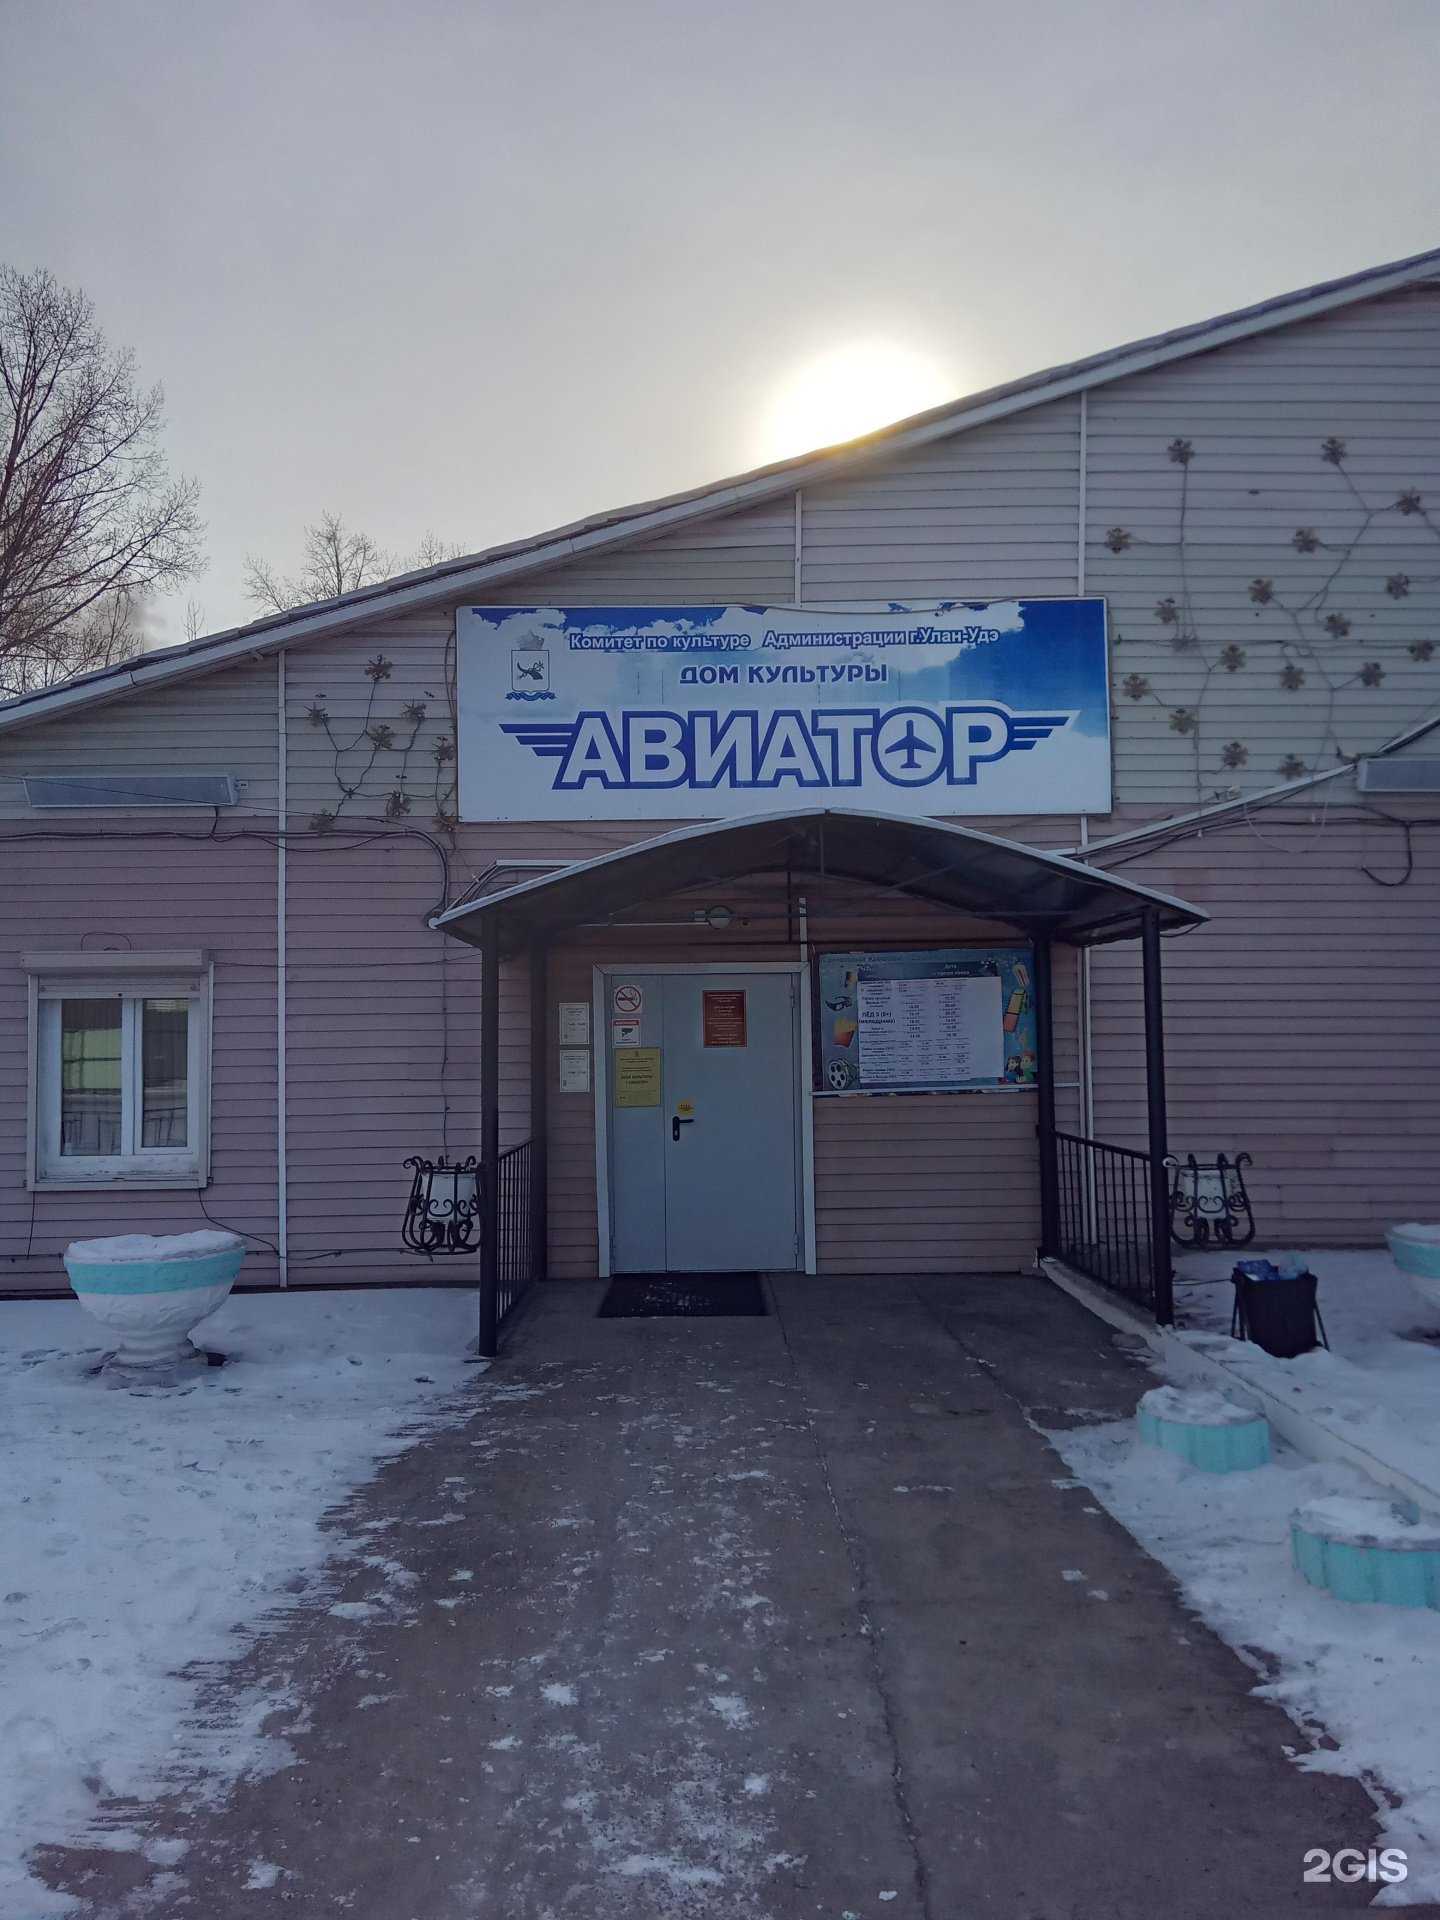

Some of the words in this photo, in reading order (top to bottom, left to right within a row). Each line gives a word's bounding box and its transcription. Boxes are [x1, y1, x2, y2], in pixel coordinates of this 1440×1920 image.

[571, 634, 642, 649] Комитет
[646, 635, 669, 648] по
[673, 634, 750, 651] культуре
[764, 631, 906, 648] Администрации
[680, 666, 739, 684] ДОМ
[749, 664, 887, 684] КУЛЬТУРЫ
[553, 706, 1010, 789] АВИАТОР
